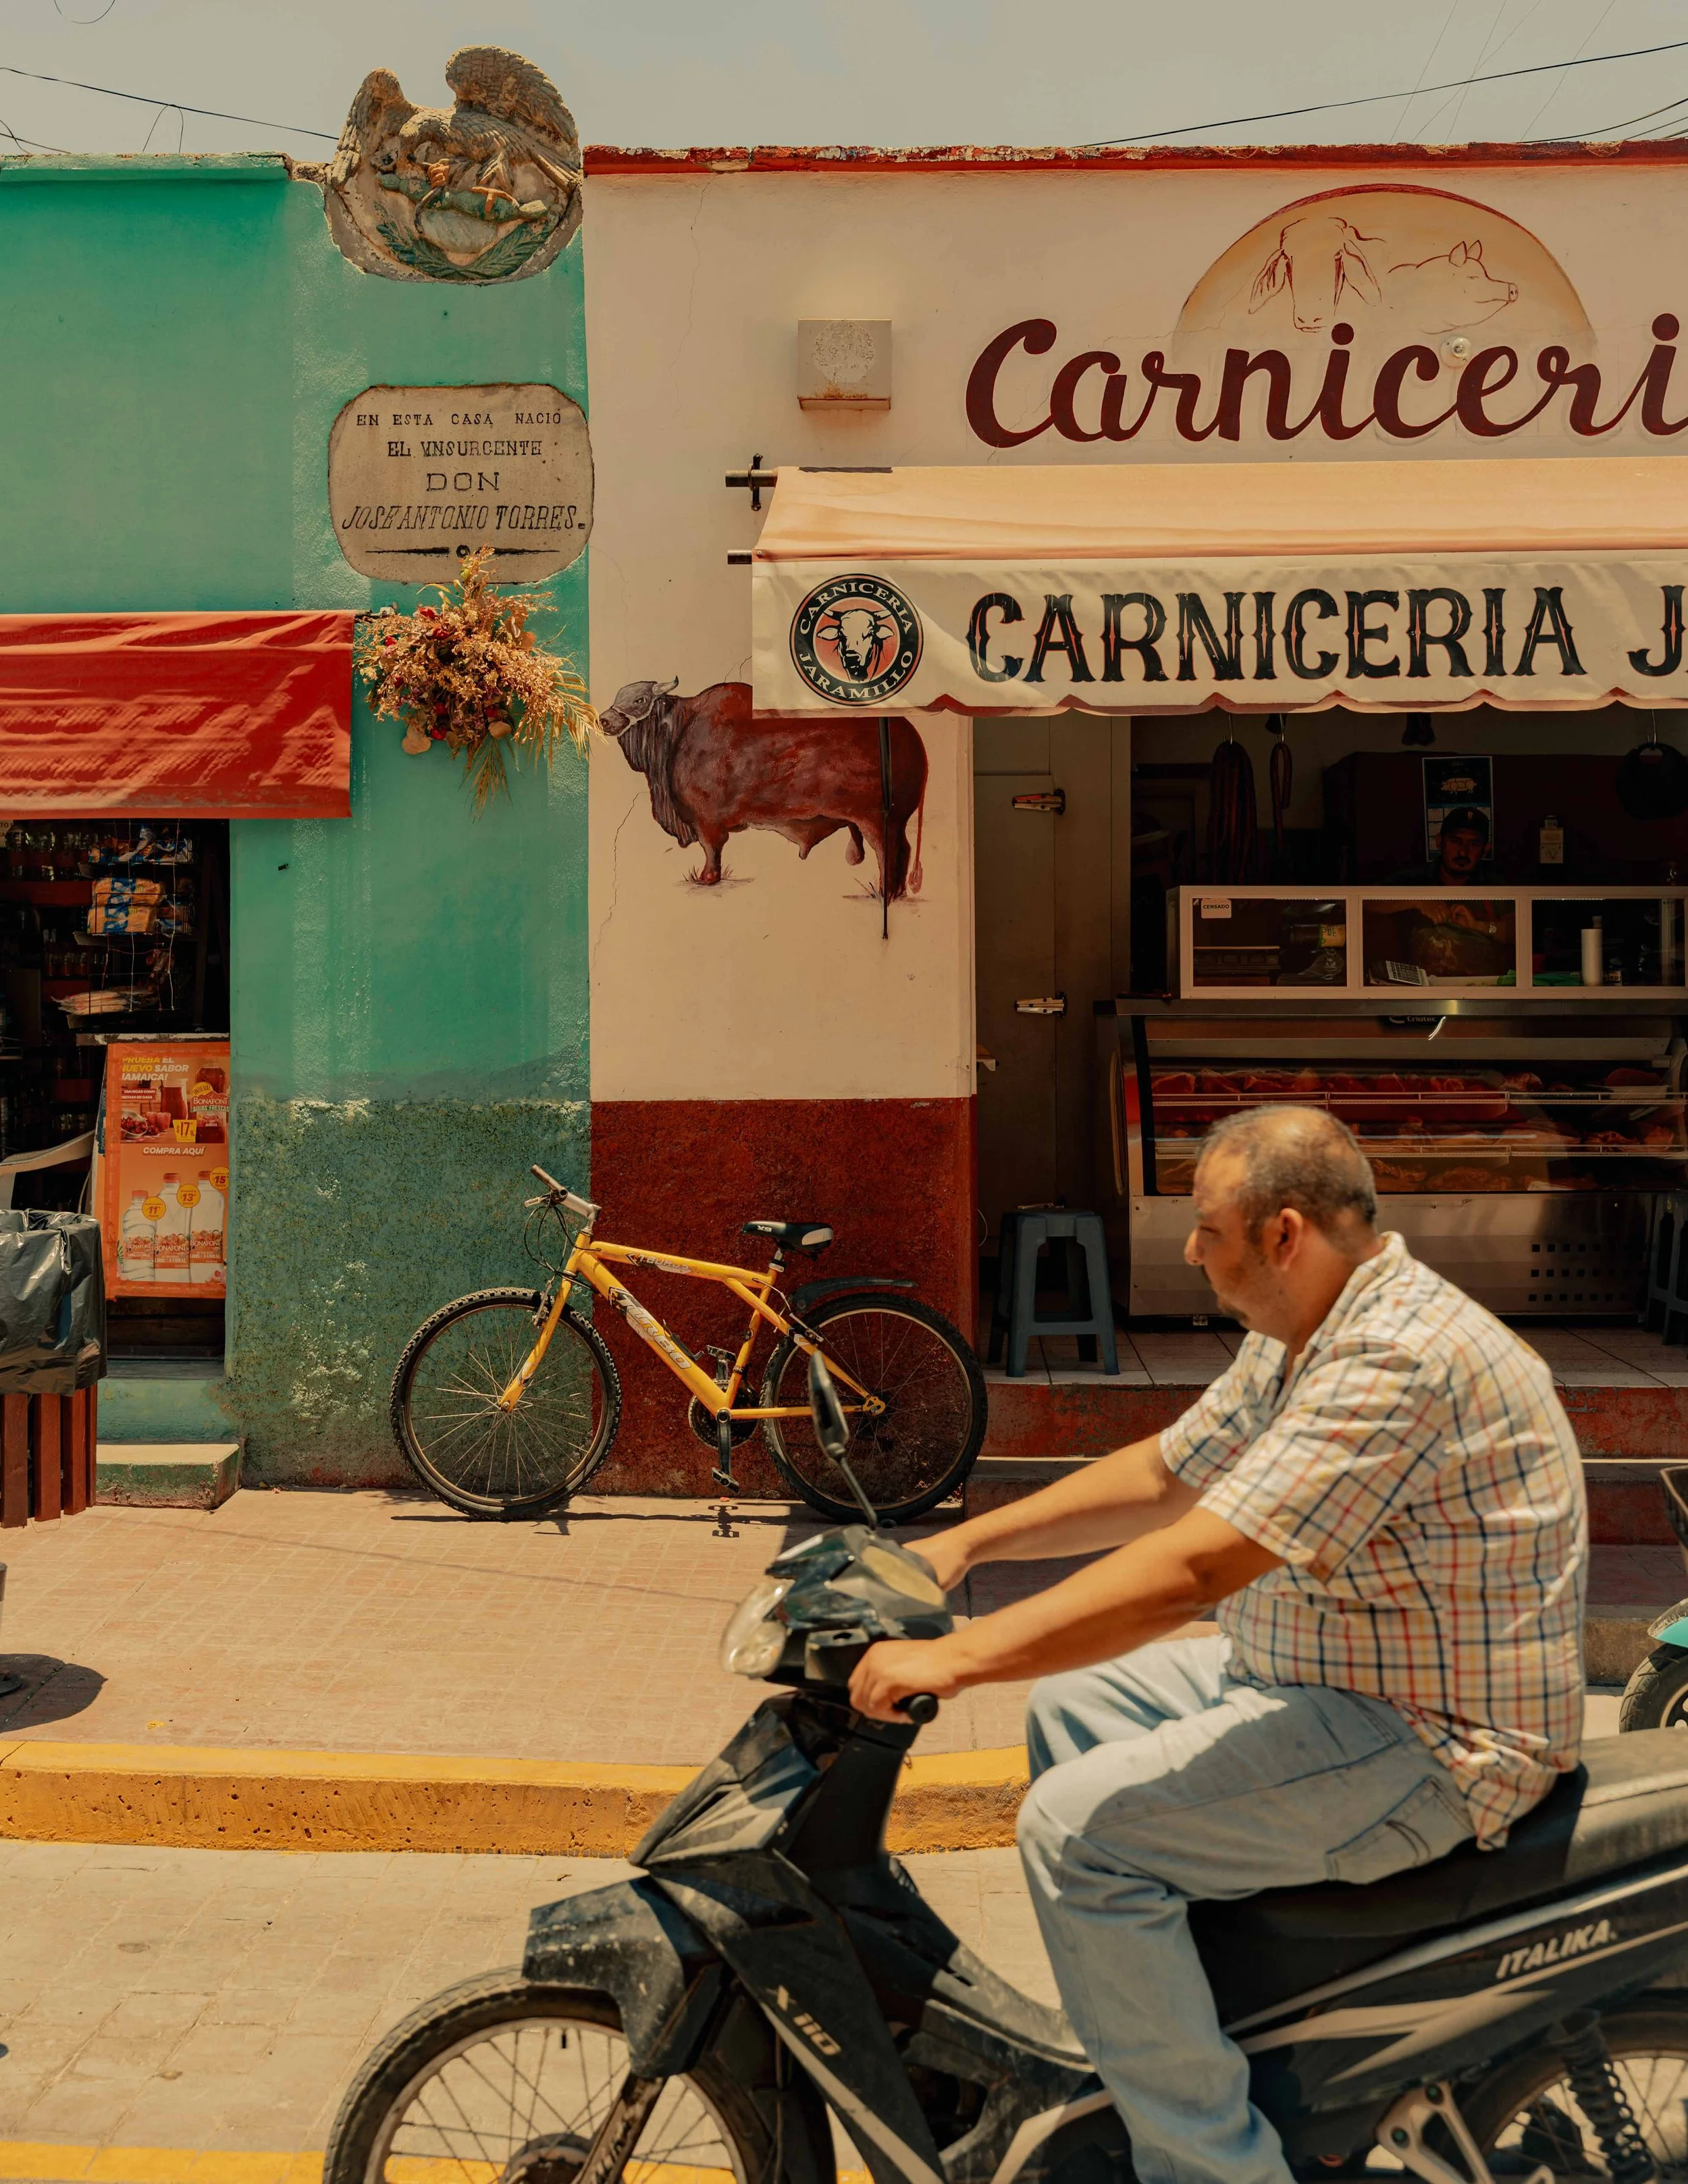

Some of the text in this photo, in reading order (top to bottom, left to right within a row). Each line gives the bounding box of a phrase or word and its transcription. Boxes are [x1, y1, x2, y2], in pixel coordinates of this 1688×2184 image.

[357, 415, 379, 426] EN
[393, 414, 433, 425] ESTA
[451, 413, 494, 425] CASA
[388, 441, 411, 457] EL
[427, 473, 500, 491] DON
[800, 583, 913, 635] CARNICERIA
[966, 587, 1587, 682] CARNICERIA
[799, 651, 913, 699] JARAMILLO
[182, 1146, 205, 1155] AQUÍ
[616, 1294, 691, 1370] TURBO
